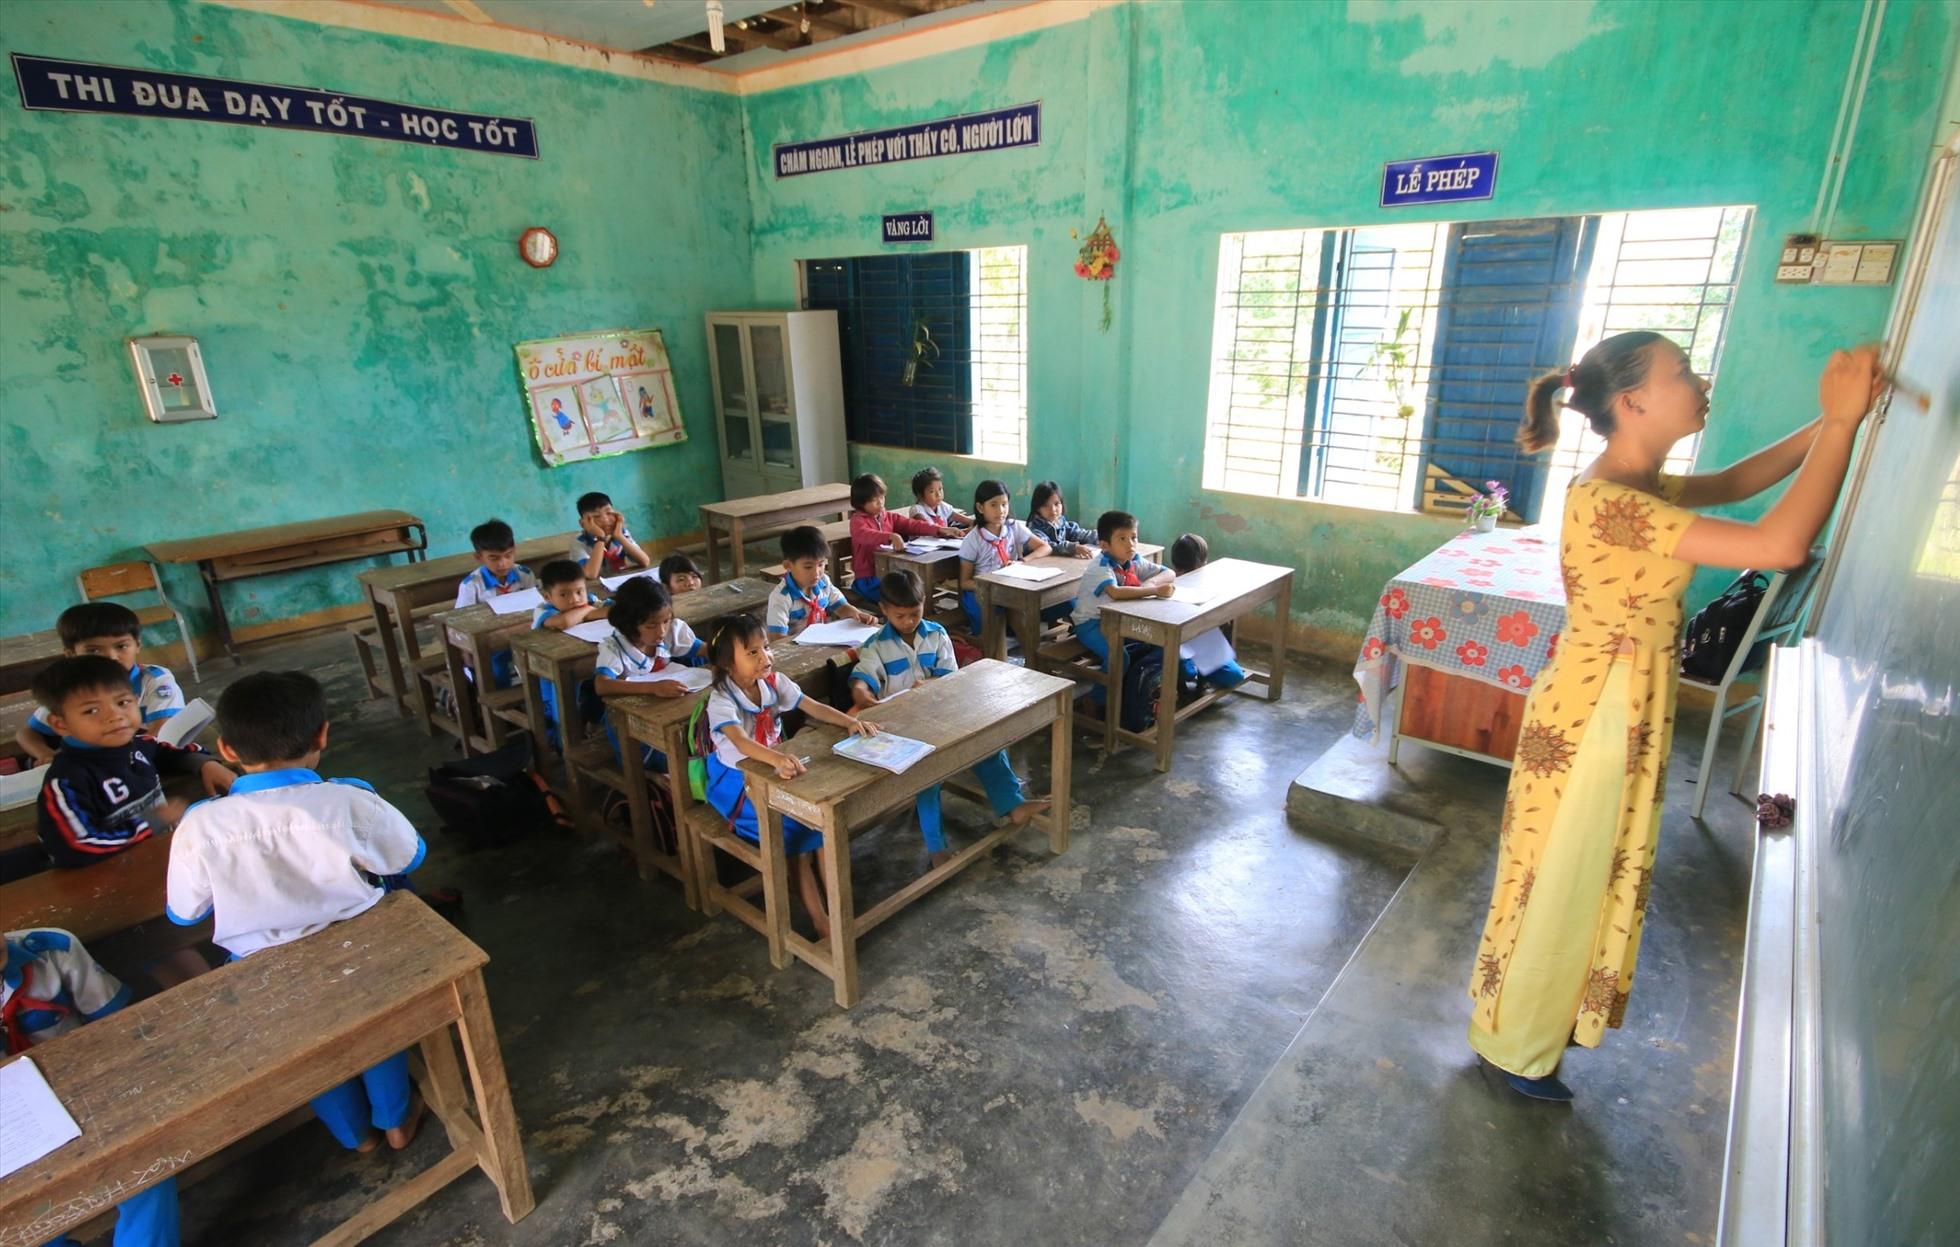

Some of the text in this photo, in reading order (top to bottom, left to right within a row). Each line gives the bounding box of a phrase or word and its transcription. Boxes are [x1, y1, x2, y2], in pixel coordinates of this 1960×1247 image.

[48, 72, 115, 104] THI
[132, 81, 209, 112] ĐUA
[224, 90, 292, 127] DẠY
[306, 97, 367, 129] TỐT
[401, 113, 460, 145] HỌC
[468, 119, 518, 148] TỐT
[808, 145, 844, 171] NGOAN,
[845, 137, 857, 166] LỄ
[857, 136, 884, 164] PHÉP
[886, 131, 906, 161] VỚI
[940, 123, 960, 154] CÔ,
[962, 116, 1003, 150] NGƯỜI
[1006, 112, 1033, 144] LỚN
[1395, 160, 1480, 195] LỄ PHÉP
[911, 215, 929, 235] LỜI
[584, 347, 603, 373] bí
[102, 776, 130, 805] G
